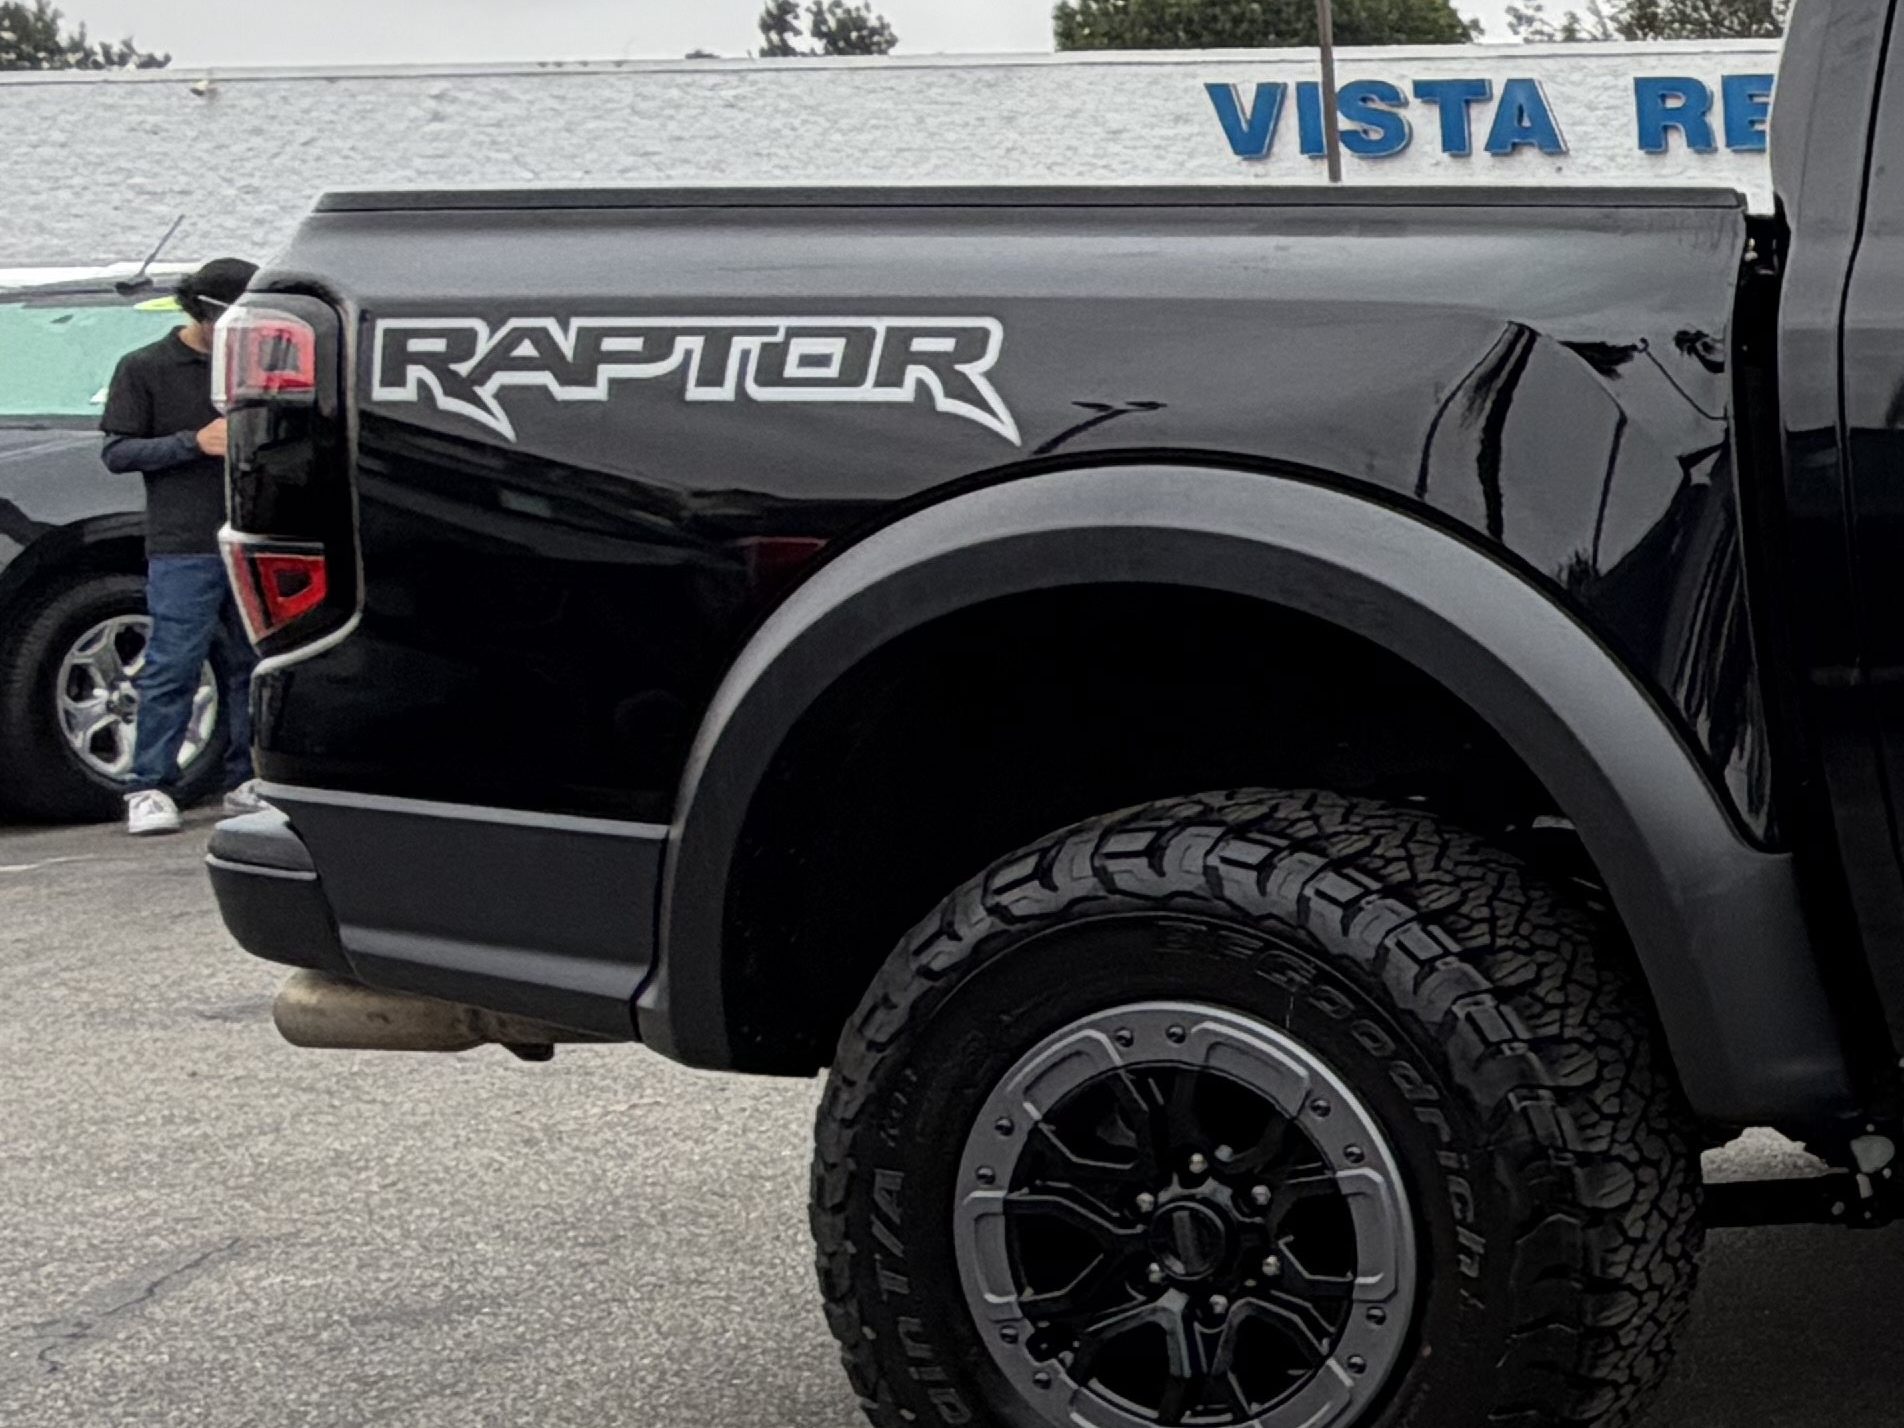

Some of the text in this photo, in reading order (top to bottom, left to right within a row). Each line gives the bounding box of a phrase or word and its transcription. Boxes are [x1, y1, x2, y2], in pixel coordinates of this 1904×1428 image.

[1204, 76, 1570, 160] VISTA
[371, 315, 1023, 447] RAPTOR
[1151, 919, 1488, 1279] BFGoodrich
